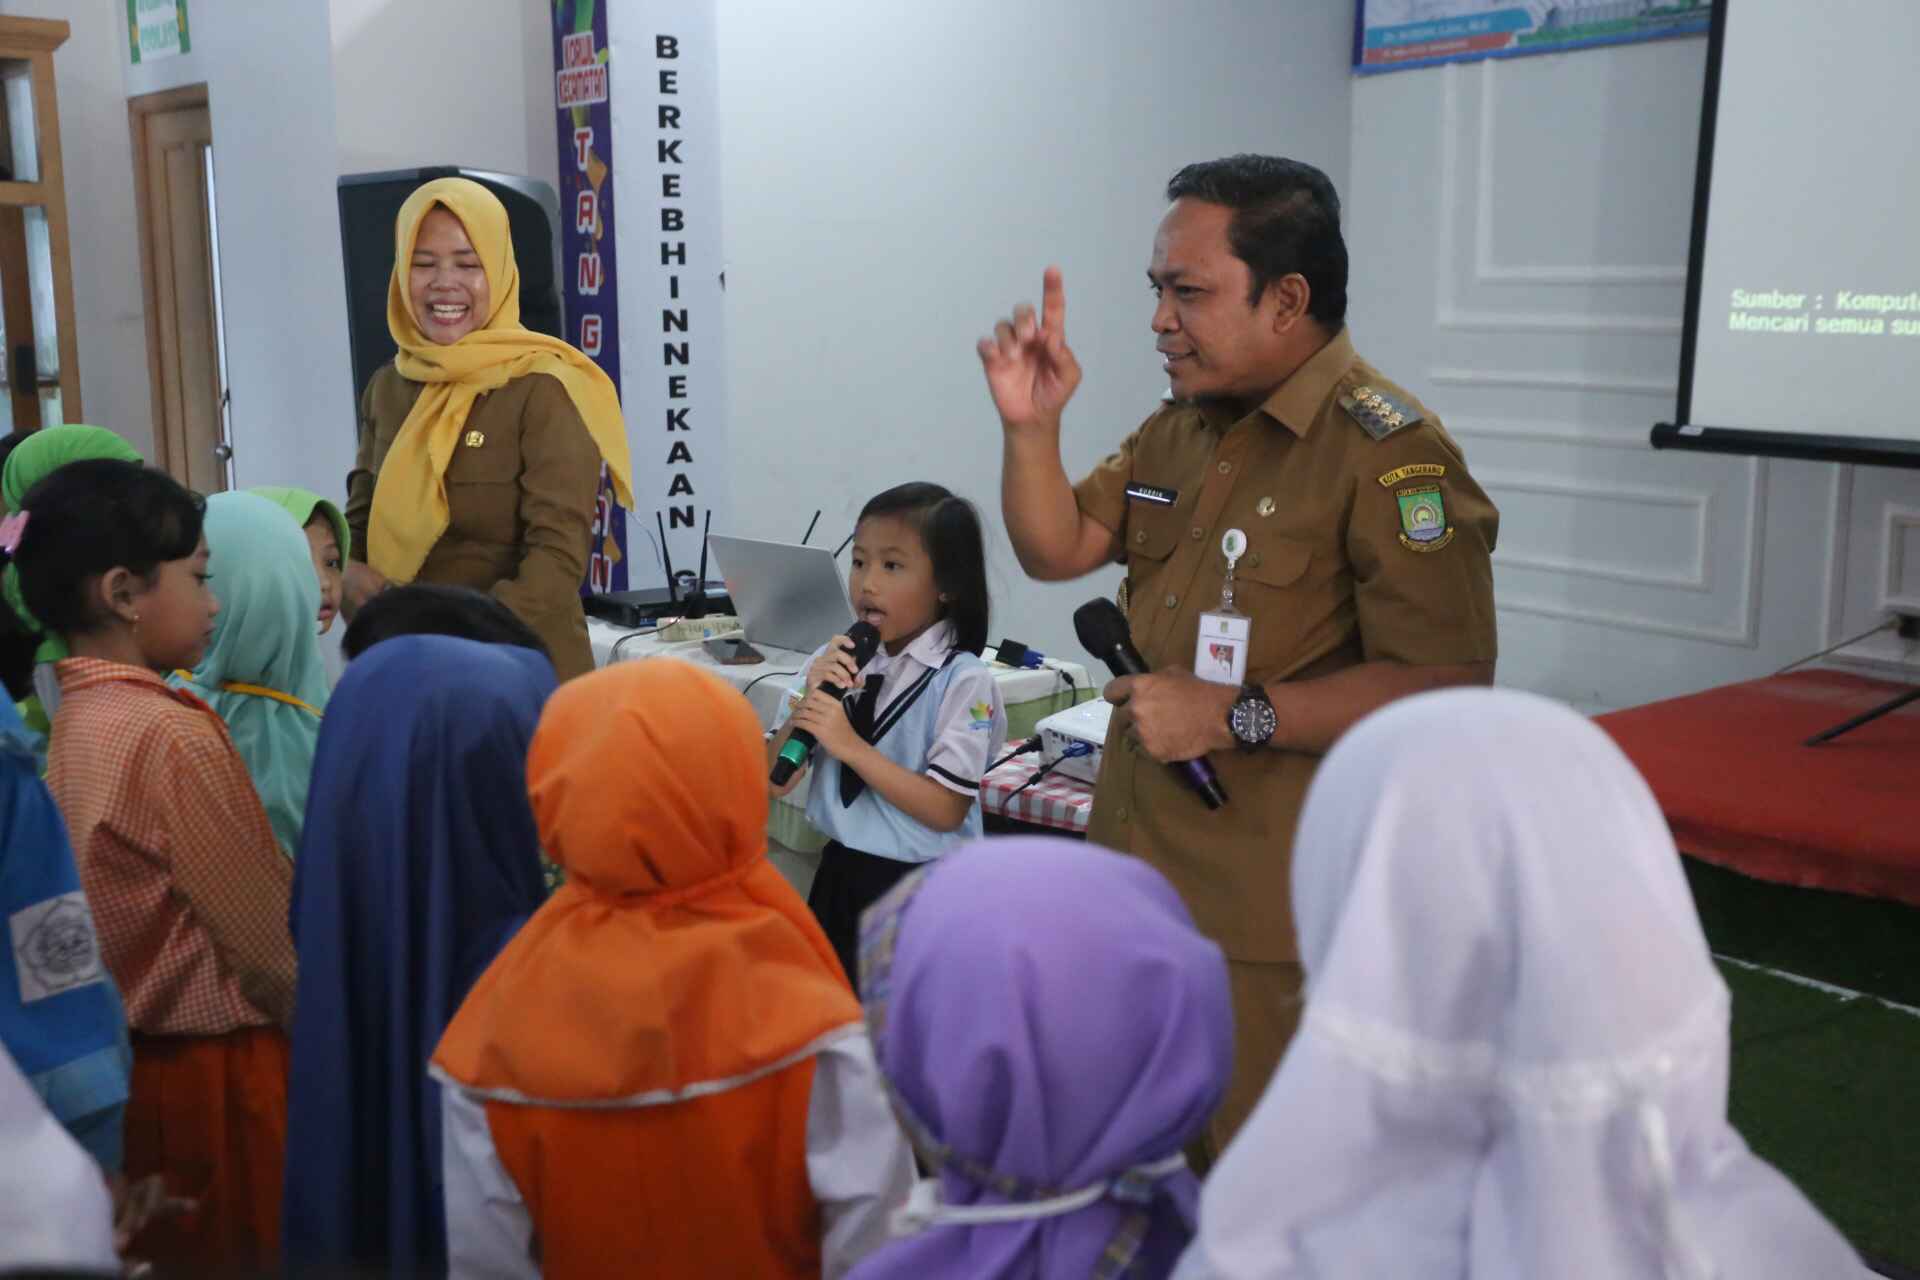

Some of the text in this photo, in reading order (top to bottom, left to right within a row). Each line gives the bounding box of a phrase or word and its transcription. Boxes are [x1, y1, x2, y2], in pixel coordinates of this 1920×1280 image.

[655, 34, 695, 529] BERKEBHINNEKAAN
[1731, 288, 1807, 309] Sumber
[1728, 311, 1809, 332] Mencari
[1814, 316, 1885, 334] semua
[1382, 466, 1442, 484] KOTA TANGERANG
